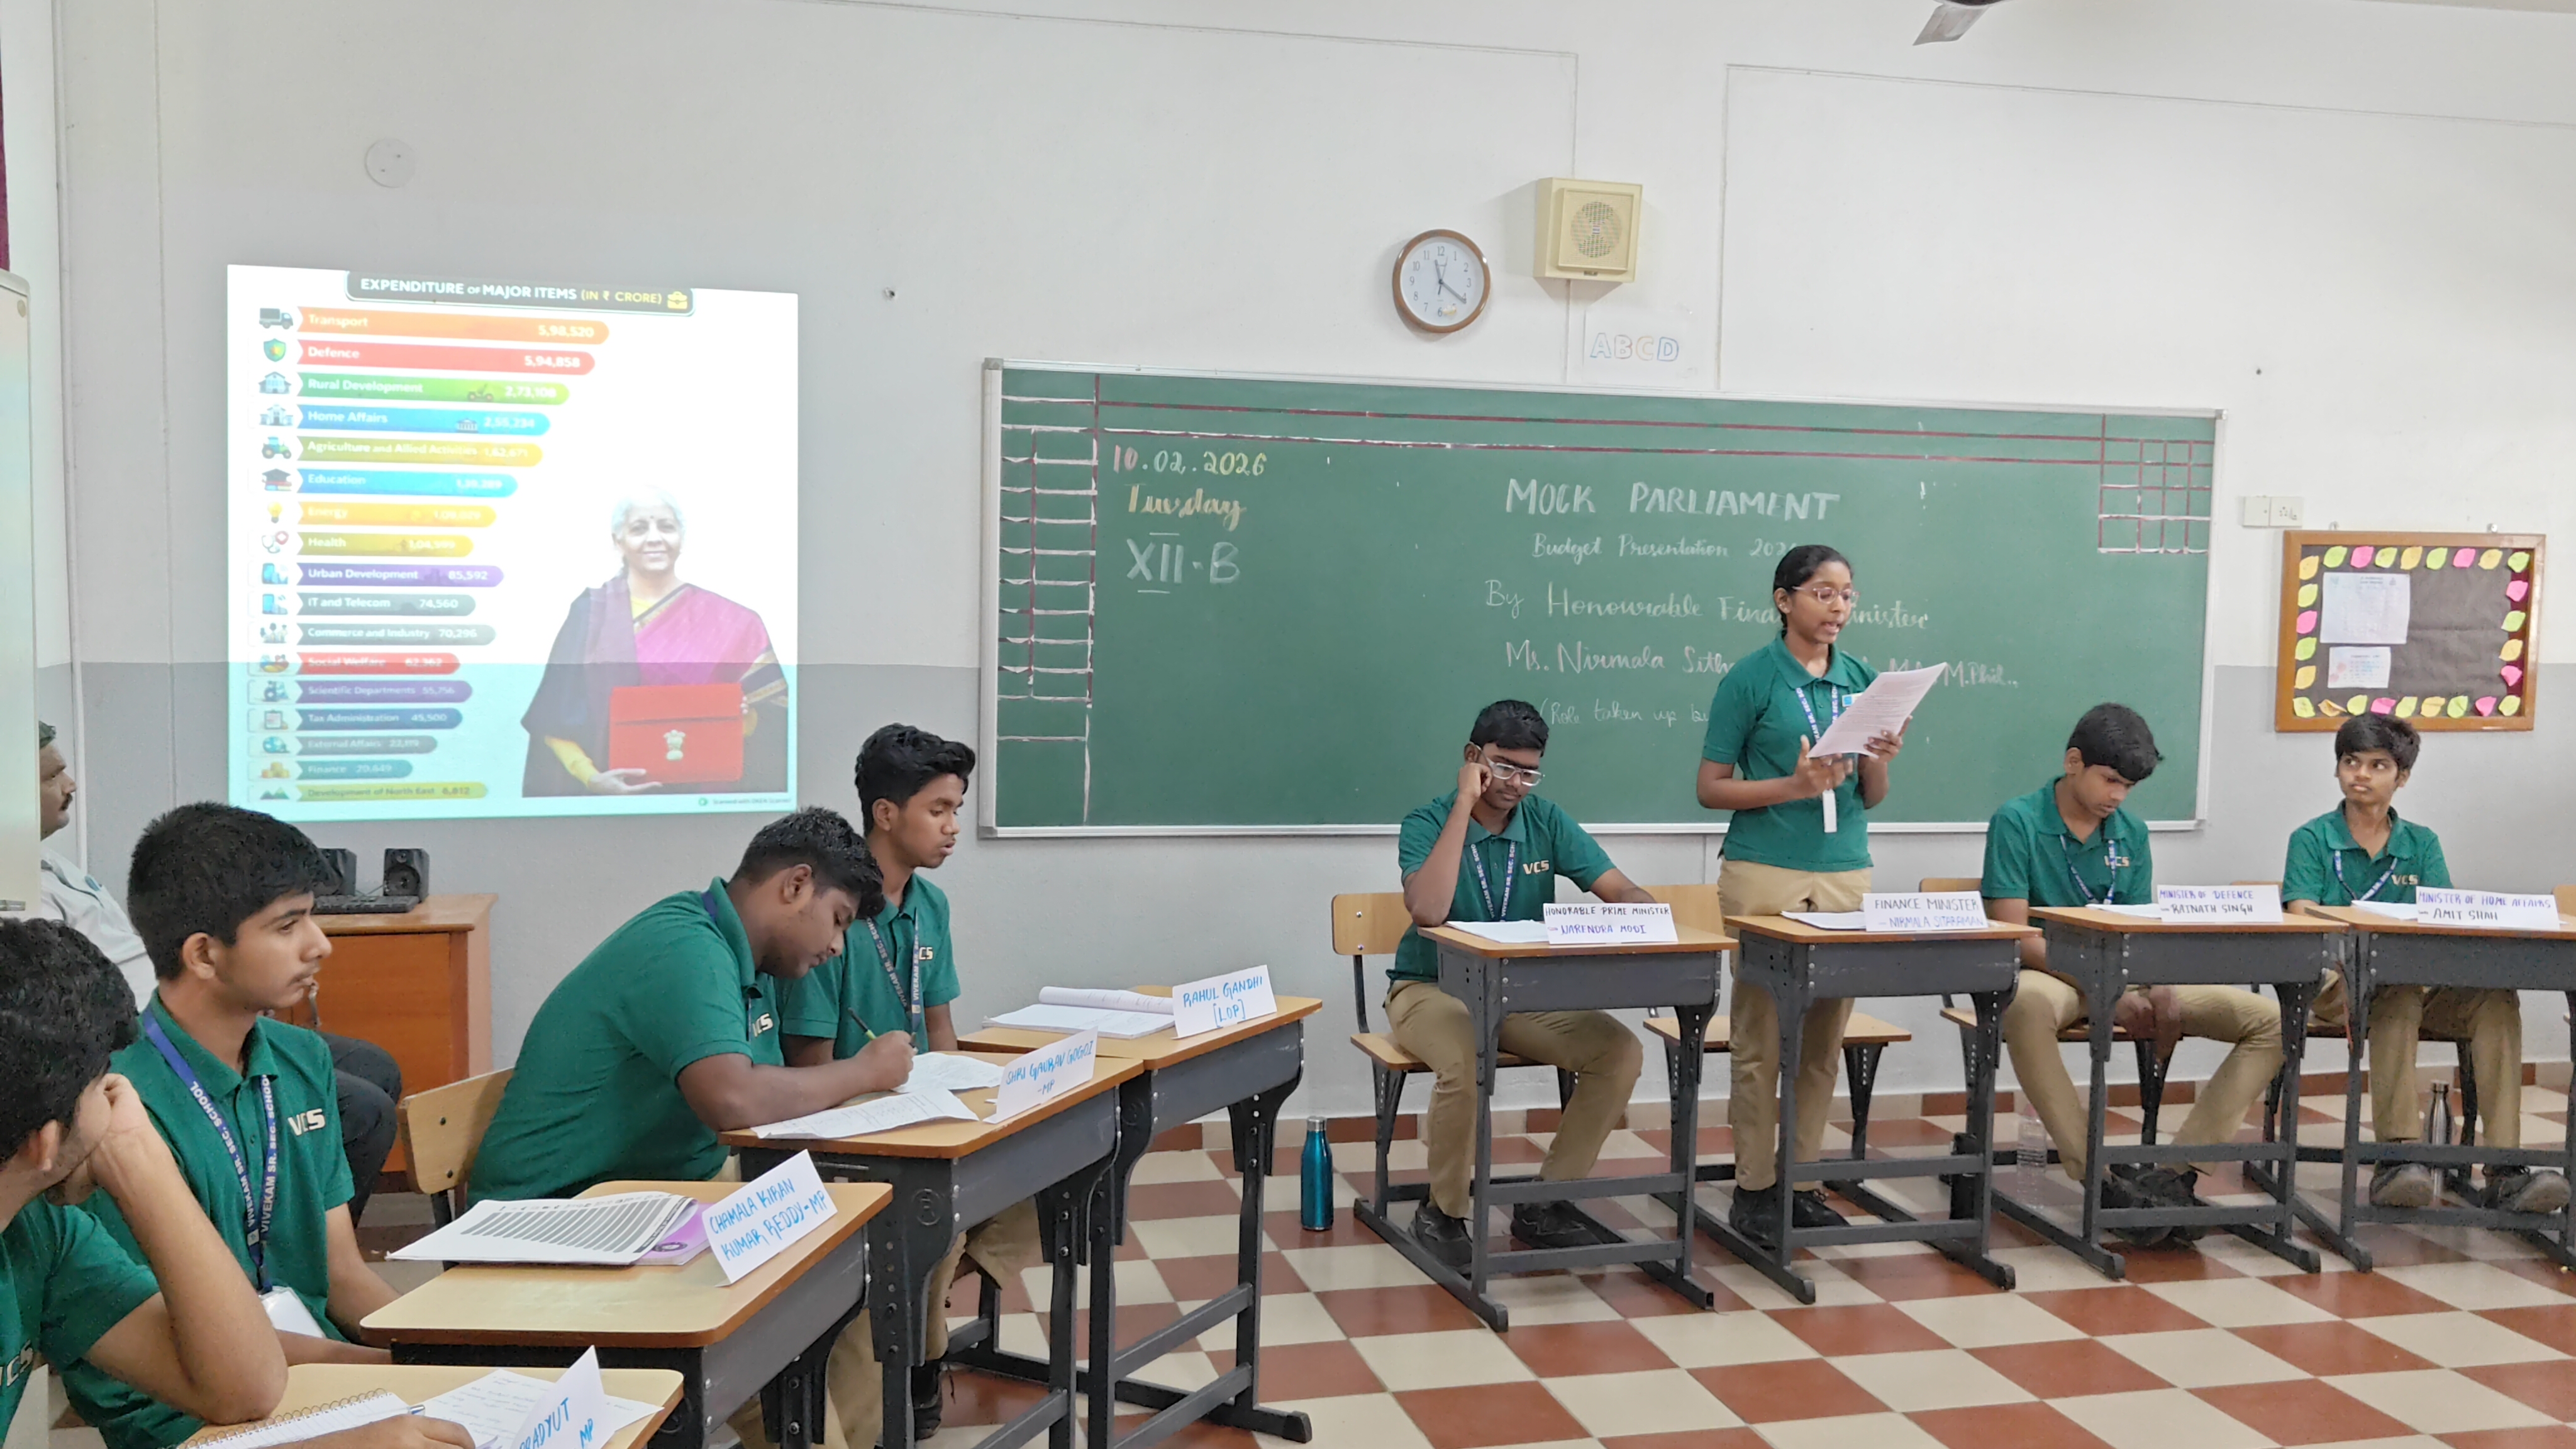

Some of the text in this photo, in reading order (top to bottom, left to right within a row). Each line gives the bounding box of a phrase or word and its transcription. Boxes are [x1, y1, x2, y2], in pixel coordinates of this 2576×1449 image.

[1424, 250, 1430, 260] 11
[1437, 246, 1445, 257] 12
[1413, 261, 1420, 271] 10
[1463, 262, 1468, 272] 2
[1409, 276, 1414, 286] 9
[1467, 278, 1471, 287] 3
[360, 278, 464, 295] EXPENDITURE
[467, 286, 480, 294] OF
[482, 284, 531, 299] MAJOR
[535, 287, 577, 300] ITEMS
[580, 289, 598, 301] (IN
[615, 291, 662, 304] CRORE)
[1414, 291, 1418, 301] 8
[1424, 303, 1428, 312] 7
[1438, 307, 1443, 317] 6
[308, 314, 595, 338] Transport 5,98,520
[308, 346, 360, 358] Defence
[1590, 332, 1679, 362] ABCD
[308, 379, 339, 390] Rural
[342, 380, 423, 394] Development
[308, 411, 345, 422] Home
[347, 411, 388, 424] Affairs
[308, 441, 370, 454] Agriculture
[372, 444, 392, 453] and
[394, 443, 426, 453] Allied
[429, 445, 478, 455] Activities
[1113, 444, 1267, 476] 10.02.2026
[308, 474, 366, 485] Education
[1506, 478, 1841, 521] MOCK PARLIAMENT
[308, 507, 348, 519] Energy
[1124, 483, 1247, 532] Tuesday
[308, 538, 346, 547] Health
[1532, 533, 1602, 565] Budget
[1619, 533, 1729, 558] Presentation
[308, 569, 342, 579] Urban
[345, 569, 418, 580] Development
[308, 597, 458, 609] IT and Telecom 74,560
[1485, 579, 1524, 619] By
[1548, 580, 1704, 618] Honourable
[1846, 600, 1929, 630] inister
[308, 628, 477, 639] Commerce and Industry 70,296
[308, 657, 341, 667] Social
[343, 658, 386, 667] Welfare
[1506, 639, 1550, 672] Ms.
[1558, 640, 1664, 674] Nirmala
[308, 686, 352, 695] Scientific
[354, 686, 415, 696] Departments
[308, 714, 325, 722] Tax
[327, 713, 399, 722] Administration
[1594, 697, 1643, 722] taken
[1653, 709, 1677, 728] up
[308, 740, 348, 748] External
[308, 788, 371, 797] Development
[1523, 859, 1550, 875] VCS
[2390, 874, 2419, 886] VCS
[2159, 889, 2254, 899] MINISTER OF DEFENCE
[2418, 891, 2551, 908] MINISTER OF HOME AFFAIRS
[1874, 897, 1979, 911] FINANCE MINISTER
[2221, 904, 2253, 915] SINGH
[1545, 906, 1670, 917] HONORABLE PRIME MINISTER
[2433, 908, 2498, 921] AMIT SHAH
[1889, 916, 1930, 928] NIRMALA
[1560, 923, 1646, 935] NARENDRA MODI
[919, 947, 933, 960] CS
[889, 972, 908, 1007] VIVEKAM
[1183, 975, 1263, 1008] RAHUL GANDHI
[1213, 999, 1246, 1028] [LOP]
[1006, 1040, 1094, 1085] SHRI GAURAV GOGOI
[262, 1074, 275, 1119] SCHOO
[287, 1108, 325, 1136] VCS
[189, 1080, 255, 1228] VIVEKAM SR. SEC. SCHOOL
[267, 1153, 277, 1173] SR.
[260, 1175, 276, 1233] VIVEKAM
[709, 1196, 758, 1235] CHAMALA
[755, 1177, 796, 1209] KIRAN
[721, 1228, 770, 1262] KUMAR
